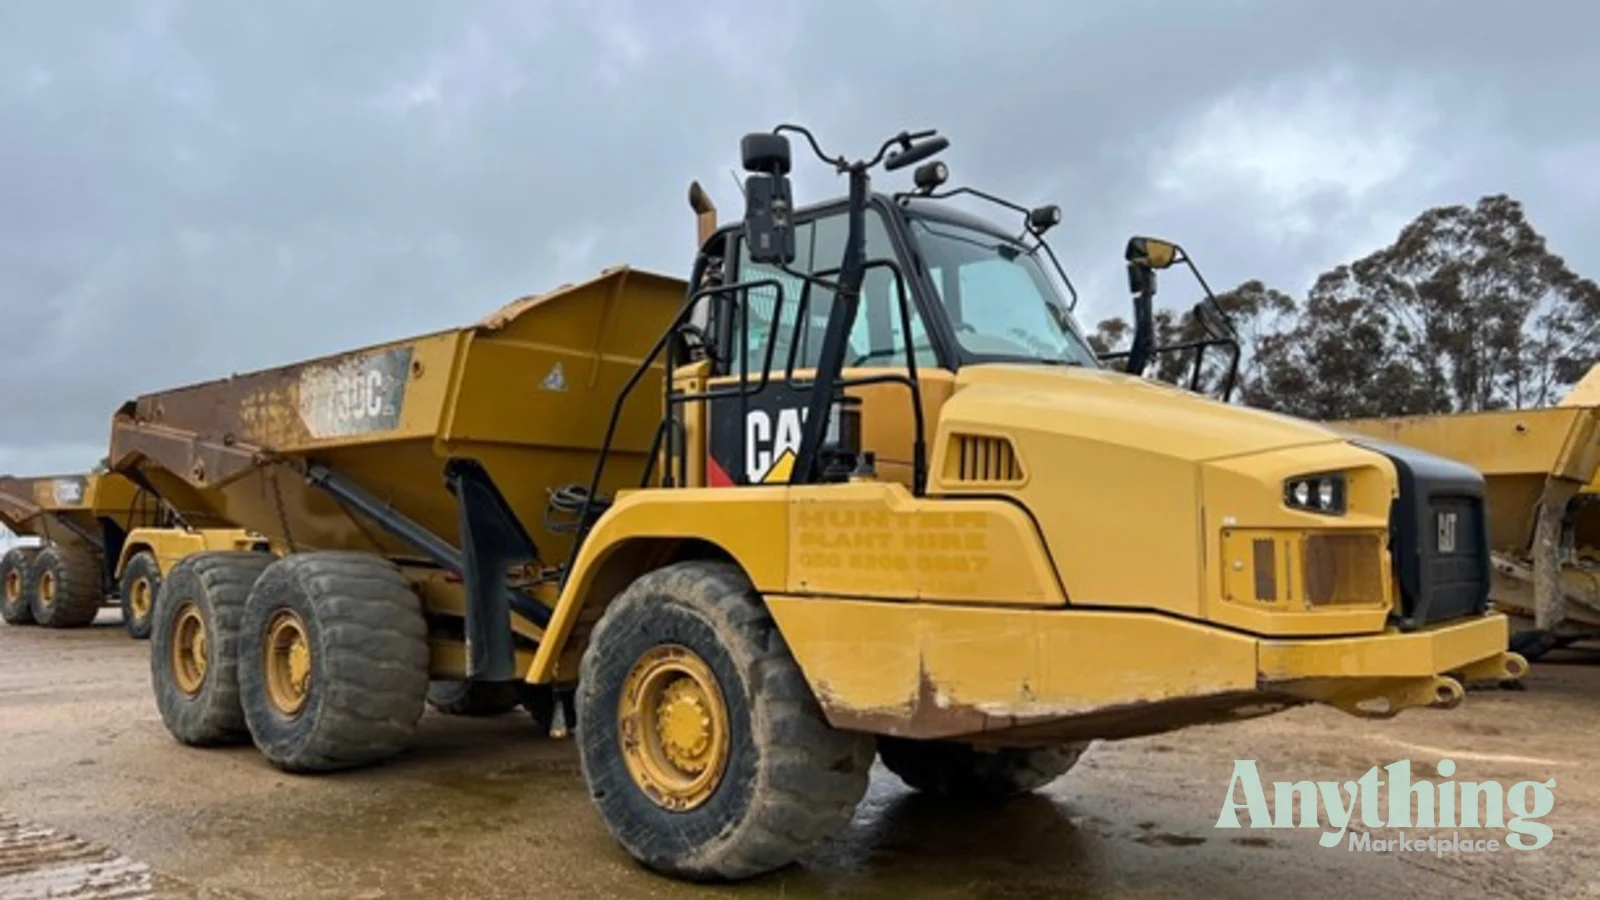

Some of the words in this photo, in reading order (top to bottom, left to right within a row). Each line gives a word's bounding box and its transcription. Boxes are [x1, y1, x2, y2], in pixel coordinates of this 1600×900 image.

[746, 408, 809, 484] CA
[800, 532, 893, 548] PLANT
[903, 533, 988, 549] HIRE
